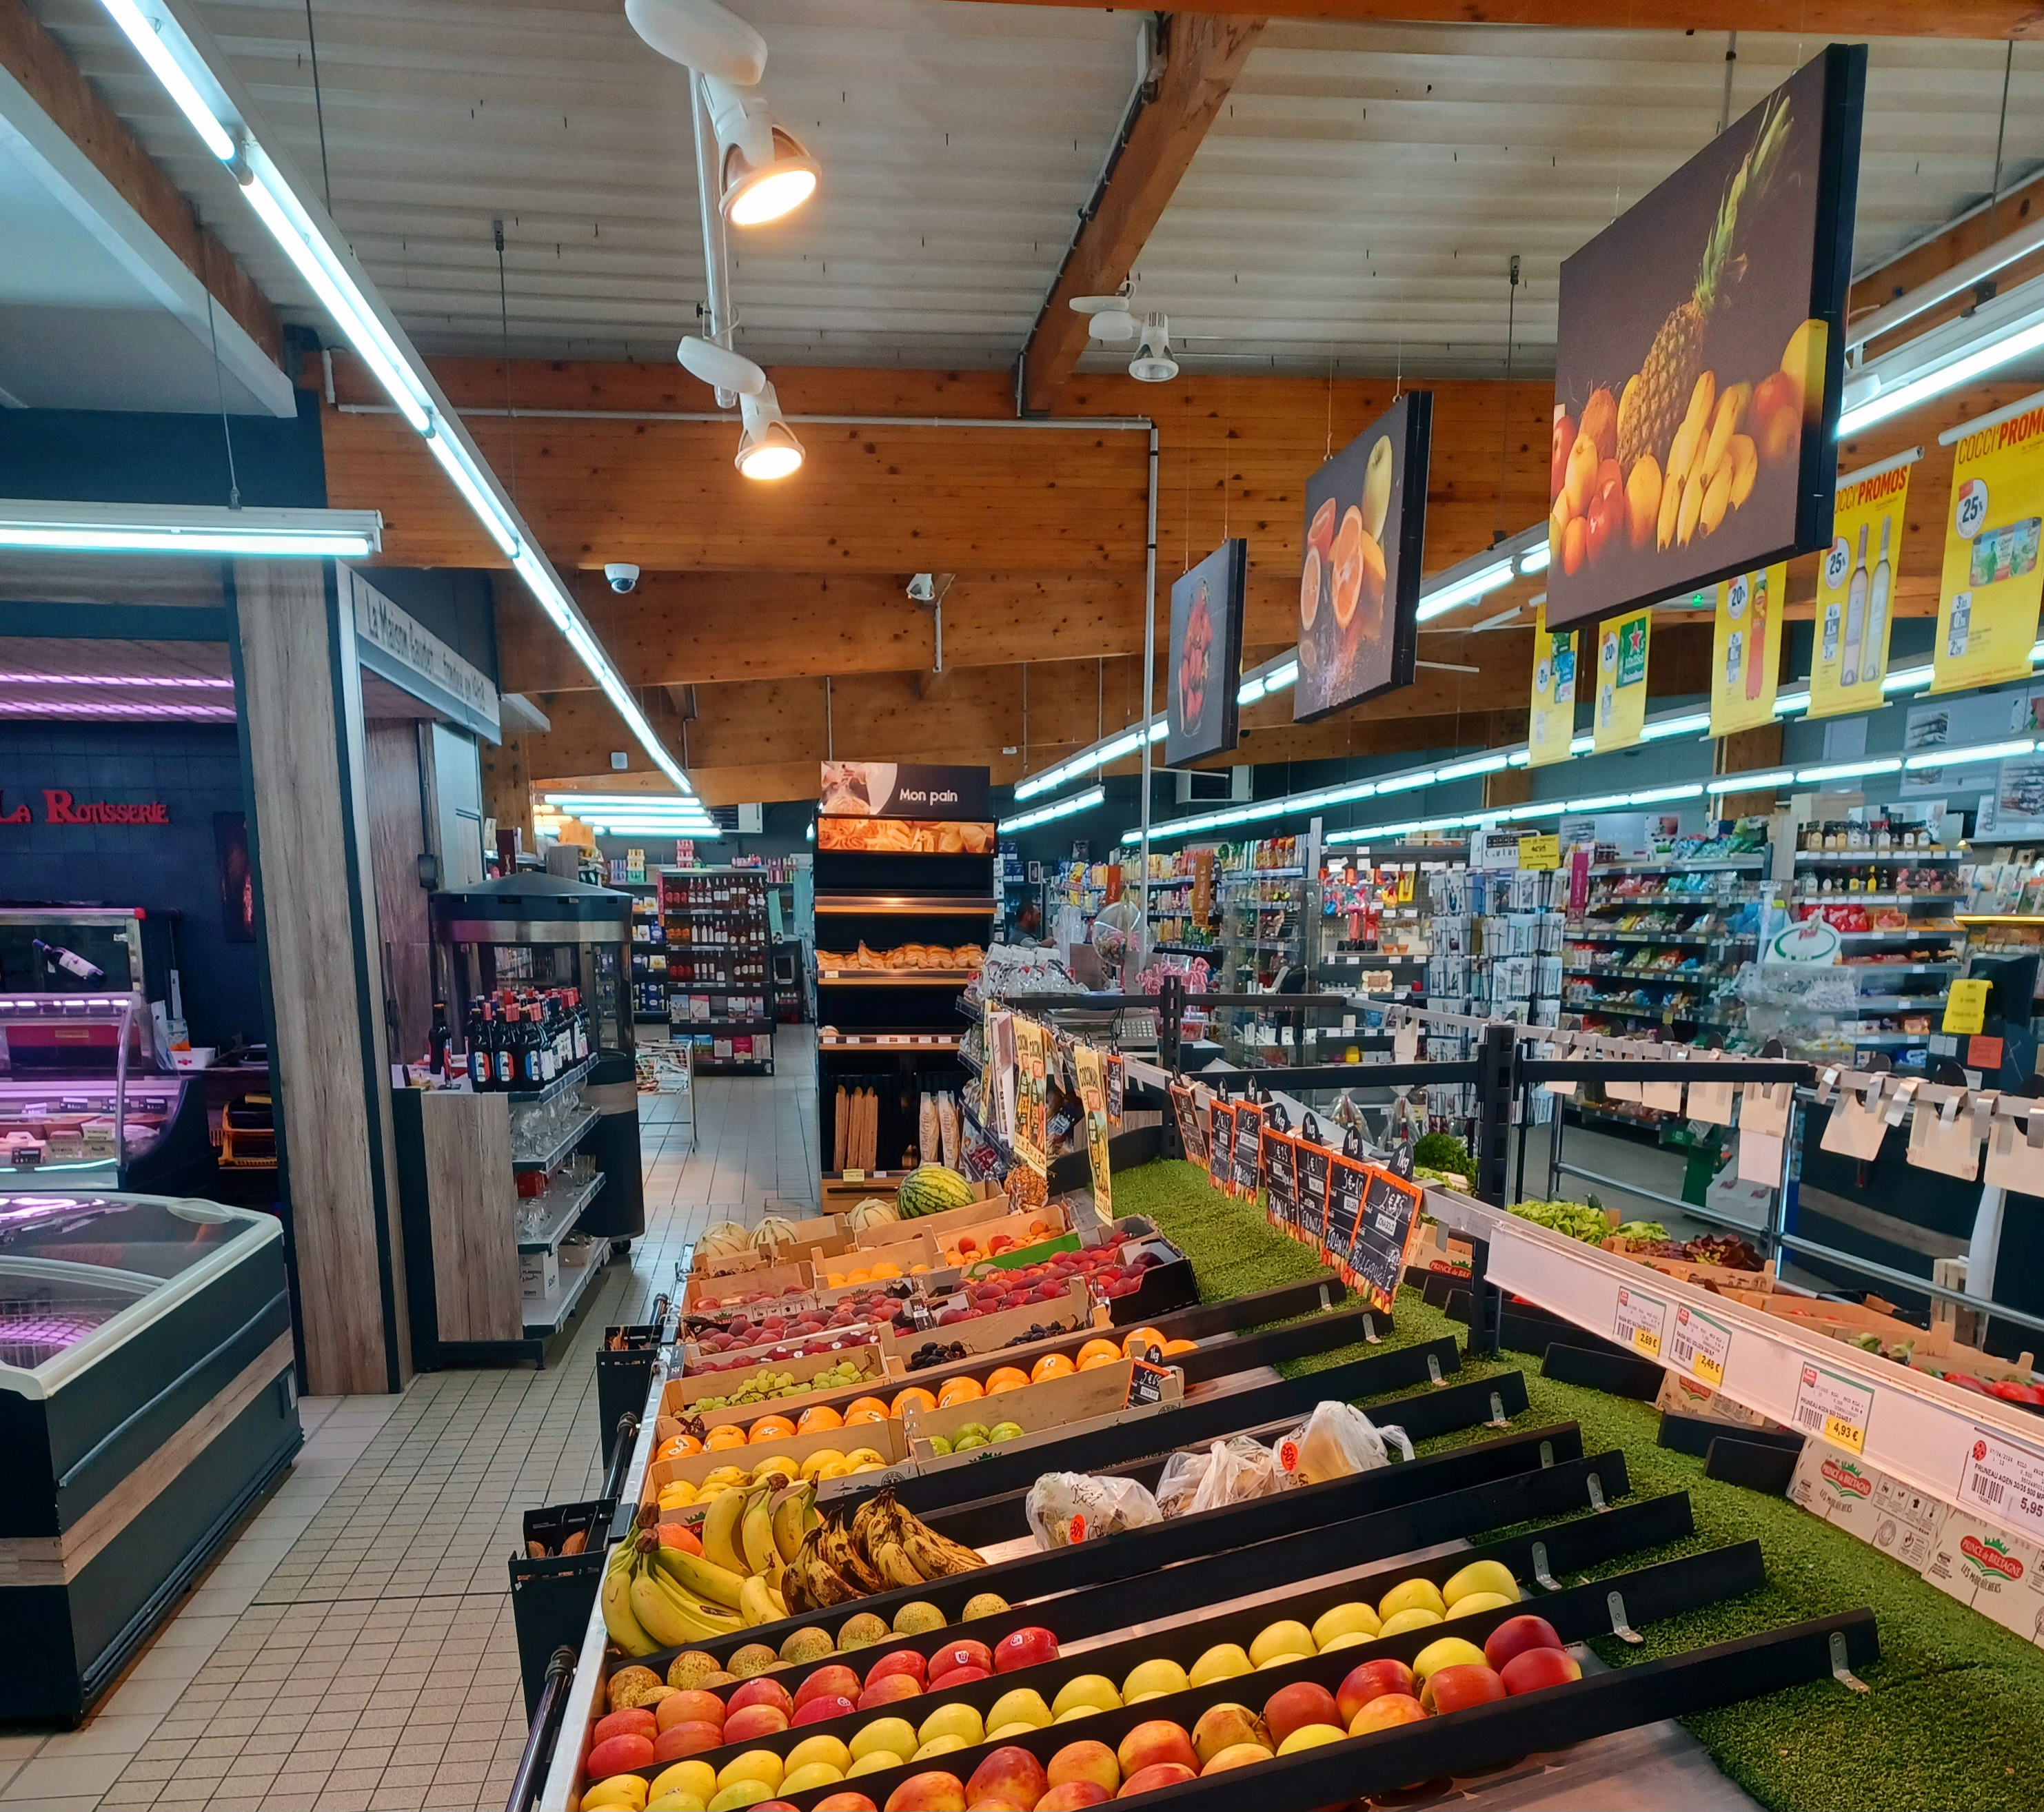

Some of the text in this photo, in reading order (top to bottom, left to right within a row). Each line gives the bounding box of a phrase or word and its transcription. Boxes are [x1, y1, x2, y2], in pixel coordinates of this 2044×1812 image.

[1998, 407, 2044, 450] PROM
[1857, 465, 1908, 506] PROMOS
[900, 788, 958, 805] Mon pain
[1275, 1106, 1286, 1132] 1kg
[1348, 1130, 1359, 1154] 1kg
[1397, 1146, 1410, 1176] 1kg
[1430, 1262, 1453, 1272] PRINCE
[1640, 1334, 1657, 1347] 2,69 €
[1150, 1346, 1160, 1363] 1kg
[1701, 1355, 1720, 1373] 2,48 €
[1801, 1396, 1817, 1409] PRUNEAU
[1818, 1405, 1829, 1414] AGEN
[1834, 1422, 1859, 1441] 4,93 €
[1282, 1445, 1297, 1471] -50%
[1822, 1463, 1839, 1480] PRINCE
[1843, 1473, 1871, 1494] BRETAGNE
[1974, 1463, 1999, 1479] PRUNEAU
[1999, 1474, 2013, 1486] AGEN
[2014, 1481, 2026, 1493] 30/35
[2027, 1488, 2036, 1497] 500
[2020, 1497, 2044, 1517] 5,95
[1962, 1539, 1984, 1557] PRINCE
[1988, 1552, 2022, 1577] BRETAGNE
[1961, 1563, 1970, 1578] LES
